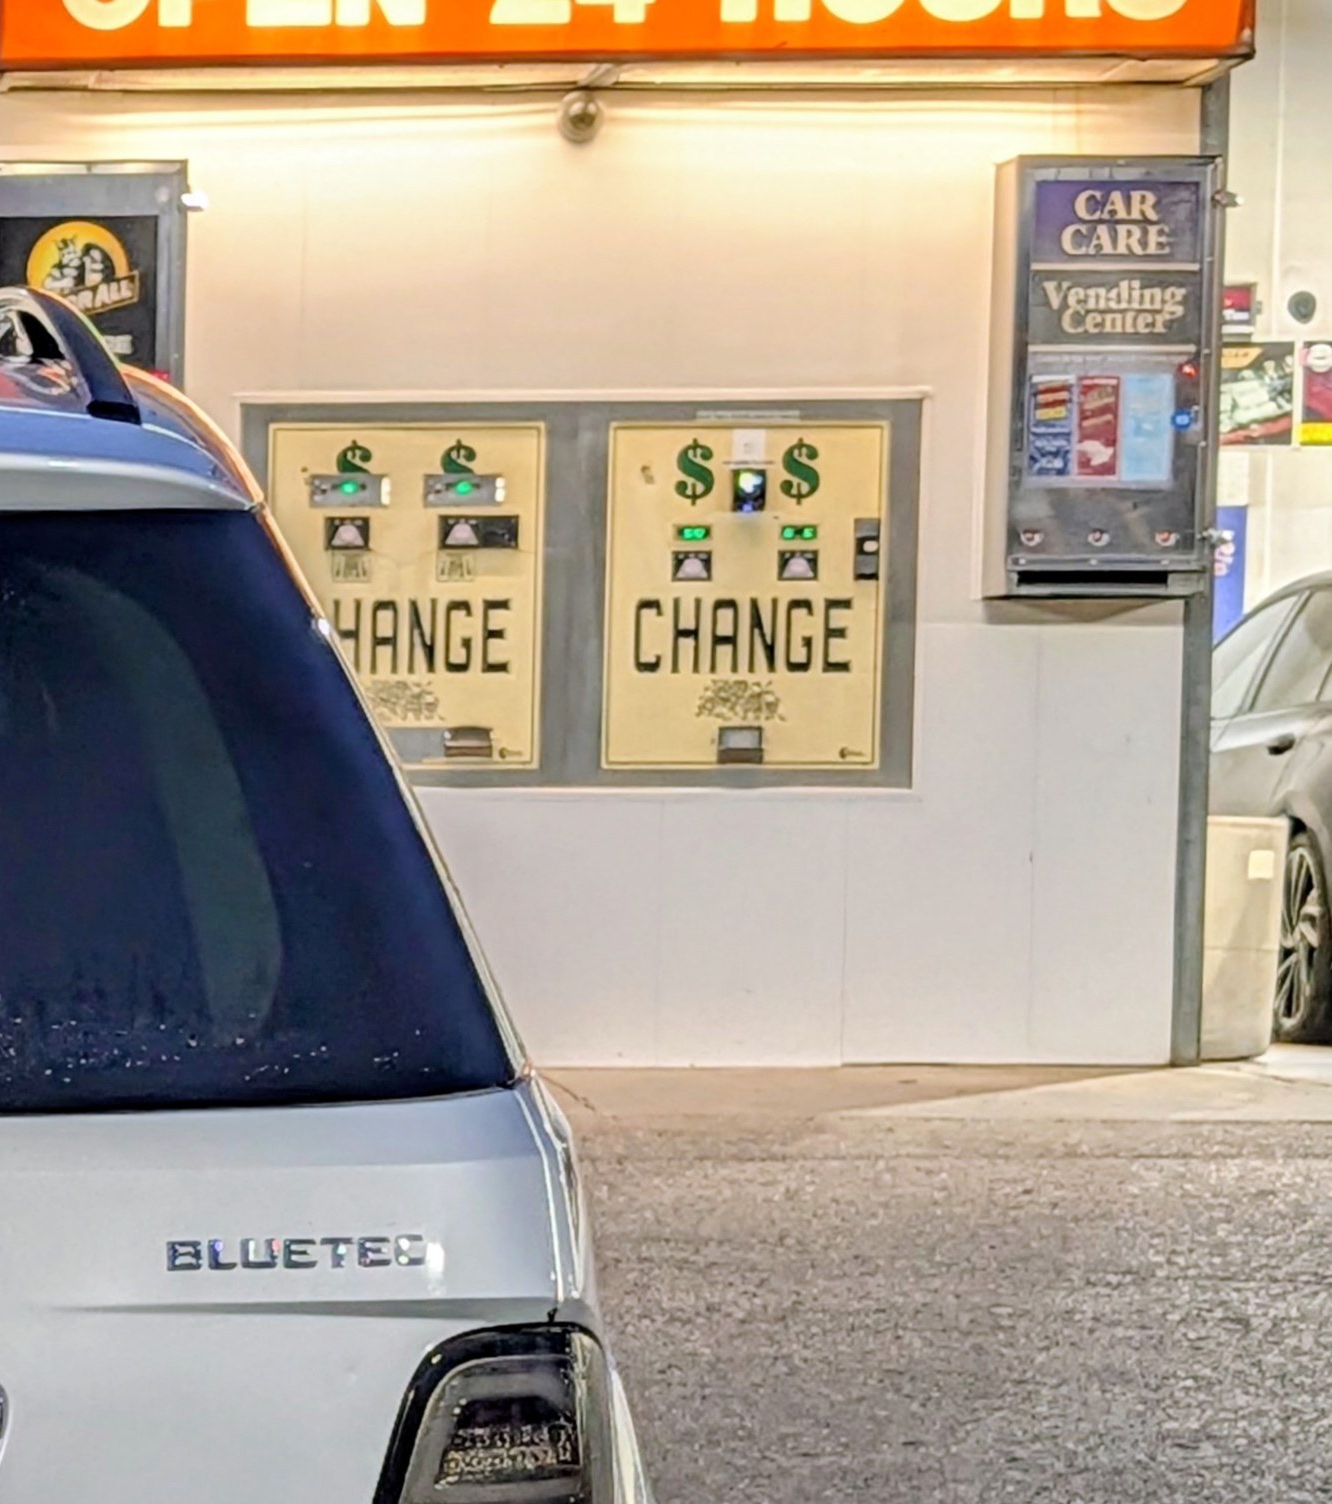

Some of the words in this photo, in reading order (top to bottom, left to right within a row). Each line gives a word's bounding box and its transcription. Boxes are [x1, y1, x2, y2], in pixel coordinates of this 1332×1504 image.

[1074, 189, 1159, 222] CAR
[1060, 223, 1171, 255] CARE
[1043, 280, 1187, 320] Vending
[1061, 307, 1169, 333] Center
[333, 598, 512, 674] HANGE
[634, 597, 854, 674] CHANGE
[166, 1234, 426, 1271] BLUETEC
